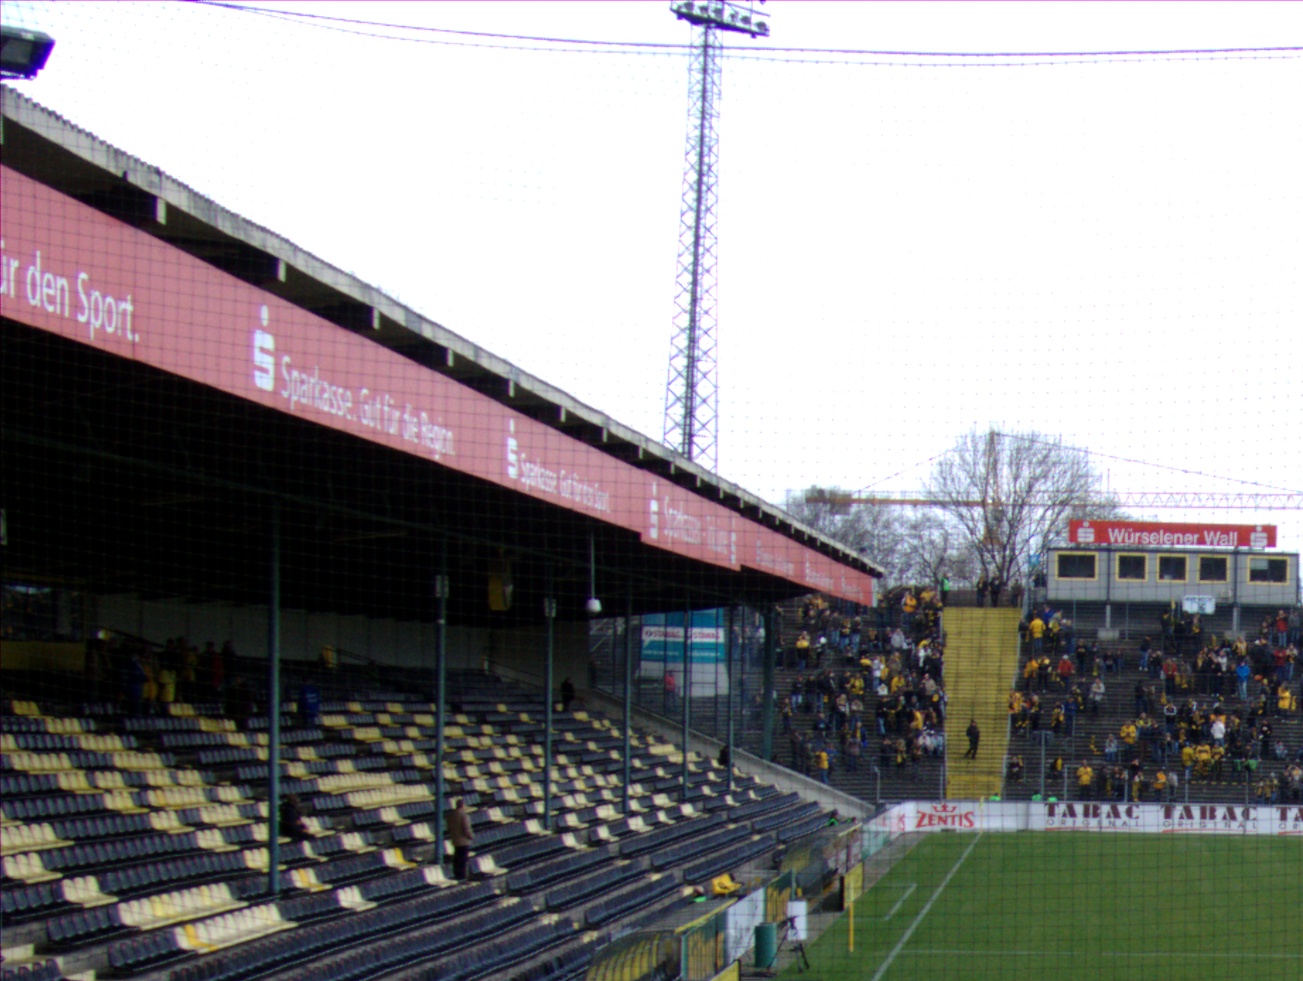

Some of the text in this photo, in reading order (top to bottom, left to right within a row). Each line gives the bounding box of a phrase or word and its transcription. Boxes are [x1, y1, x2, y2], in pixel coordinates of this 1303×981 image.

[27, 250, 69, 317] den
[77, 272, 140, 342] Sport.
[281, 355, 357, 421] Sparkasse.
[359, 388, 381, 430] Gut
[383, 393, 400, 435] für
[1108, 527, 1238, 547] Würselener Wall
[915, 810, 974, 829] ZENTIS
[1044, 802, 1140, 819] TABAC
[1160, 804, 1257, 821] TABAC
[1046, 819, 1140, 828] ORIGINAL
[1163, 820, 1257, 829] ORIGINAL
